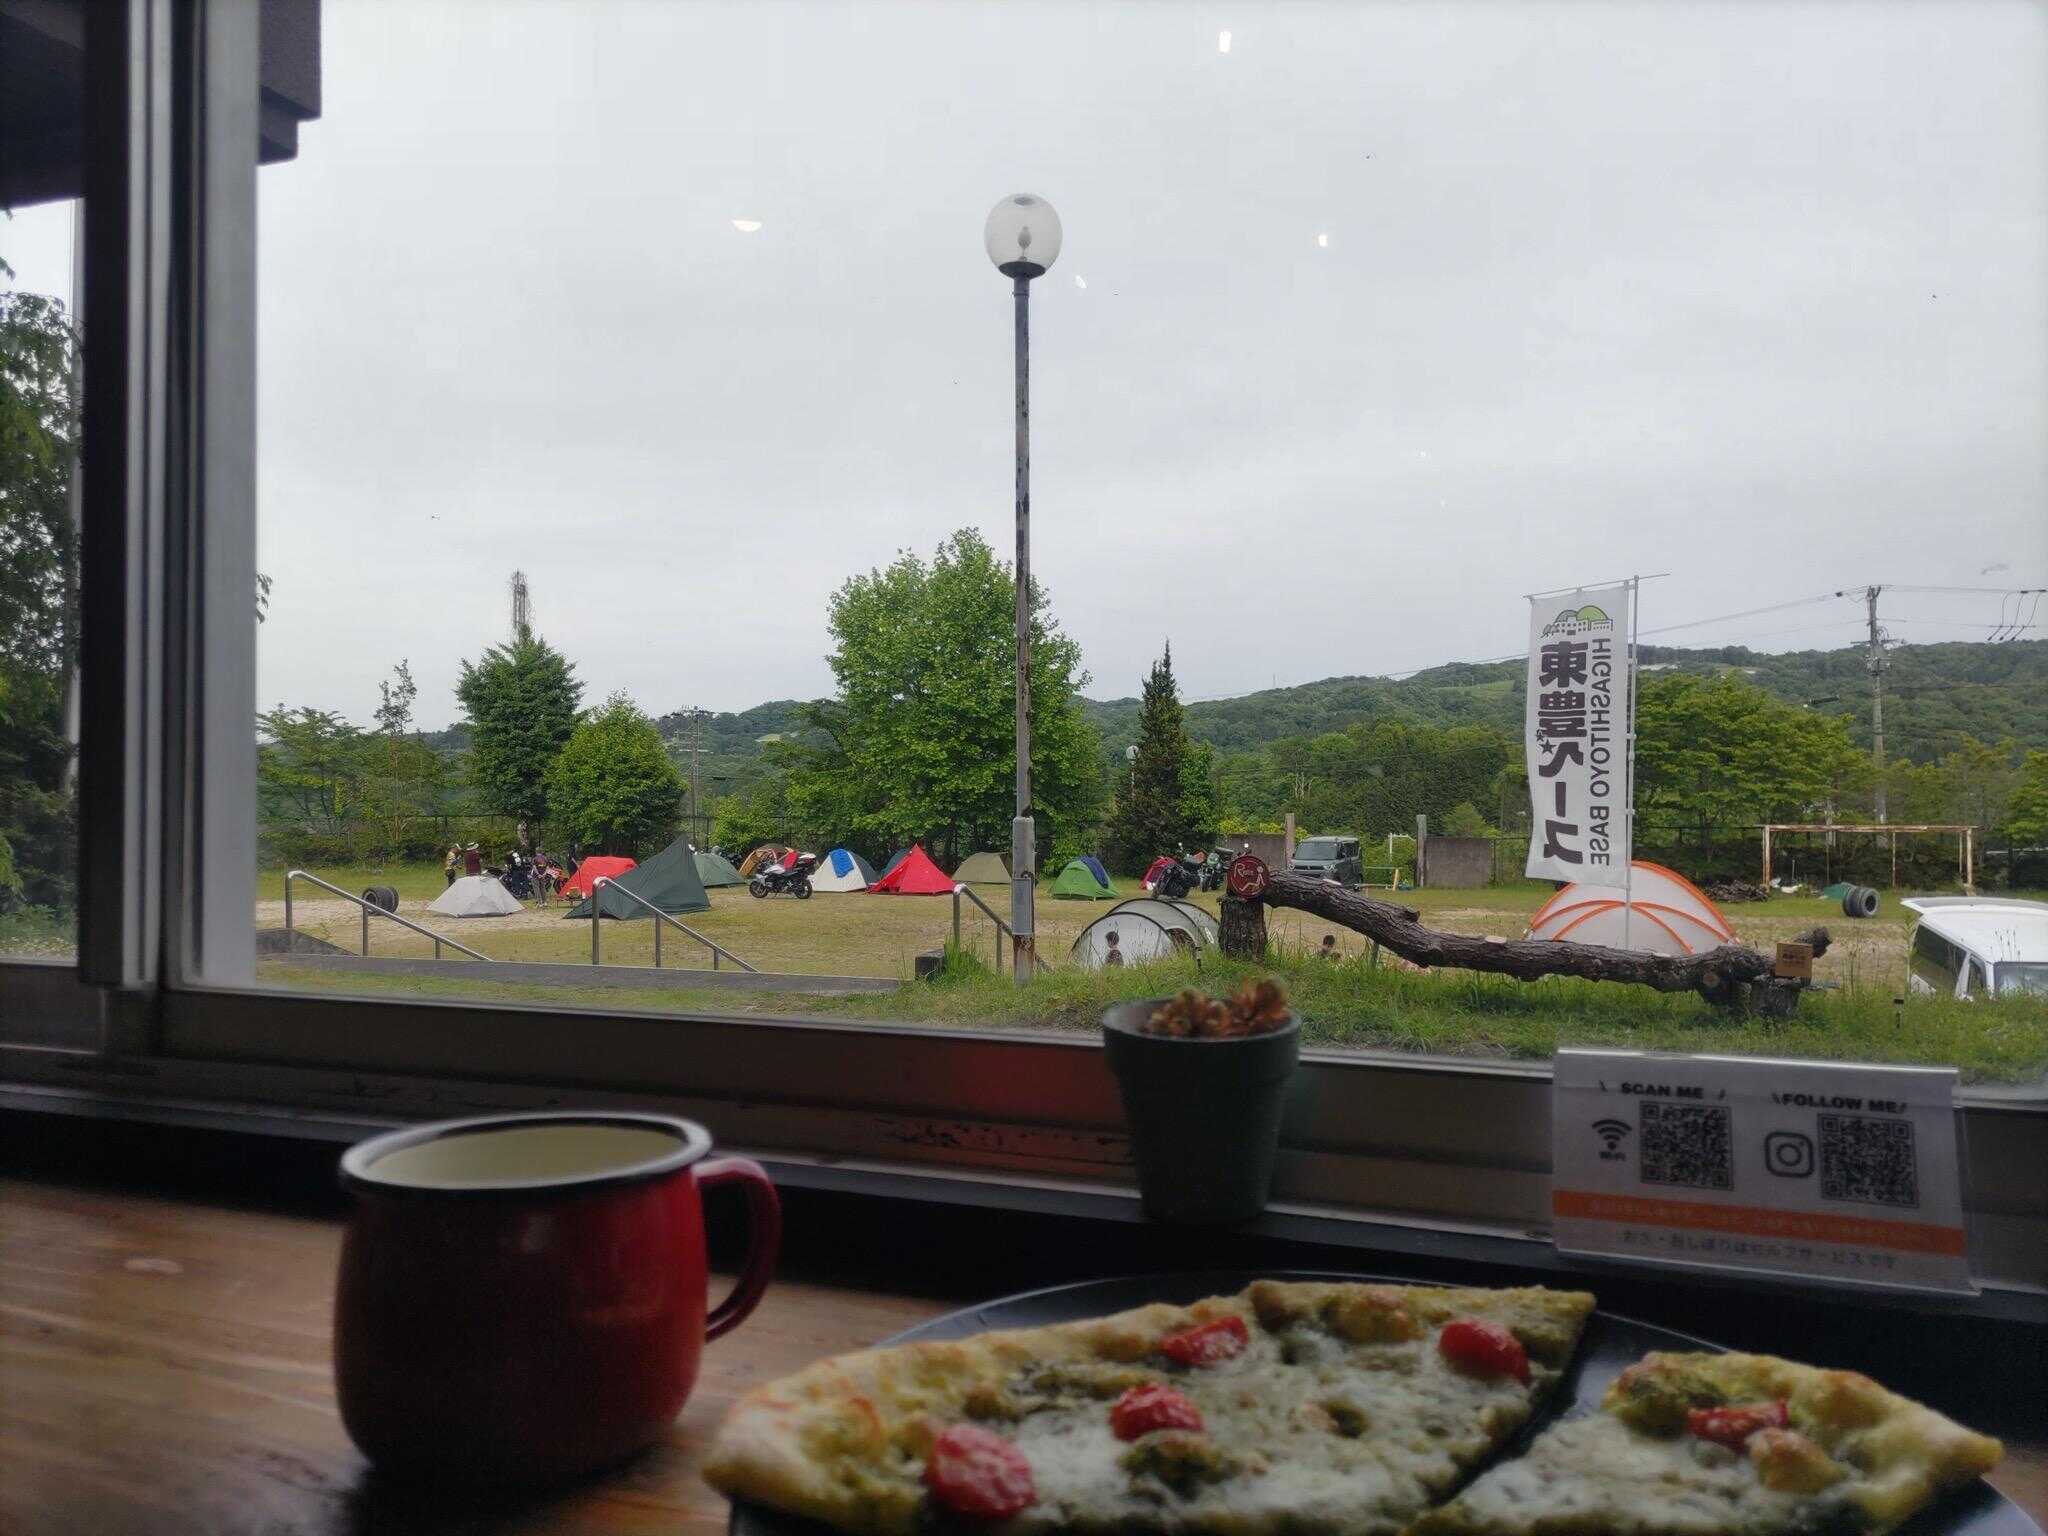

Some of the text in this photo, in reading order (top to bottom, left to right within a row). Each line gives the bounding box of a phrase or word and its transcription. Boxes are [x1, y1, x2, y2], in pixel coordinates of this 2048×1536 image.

[1621, 1082, 1704, 1099] SCAN ME
[1782, 1093, 1897, 1113] FOLLOW ME
